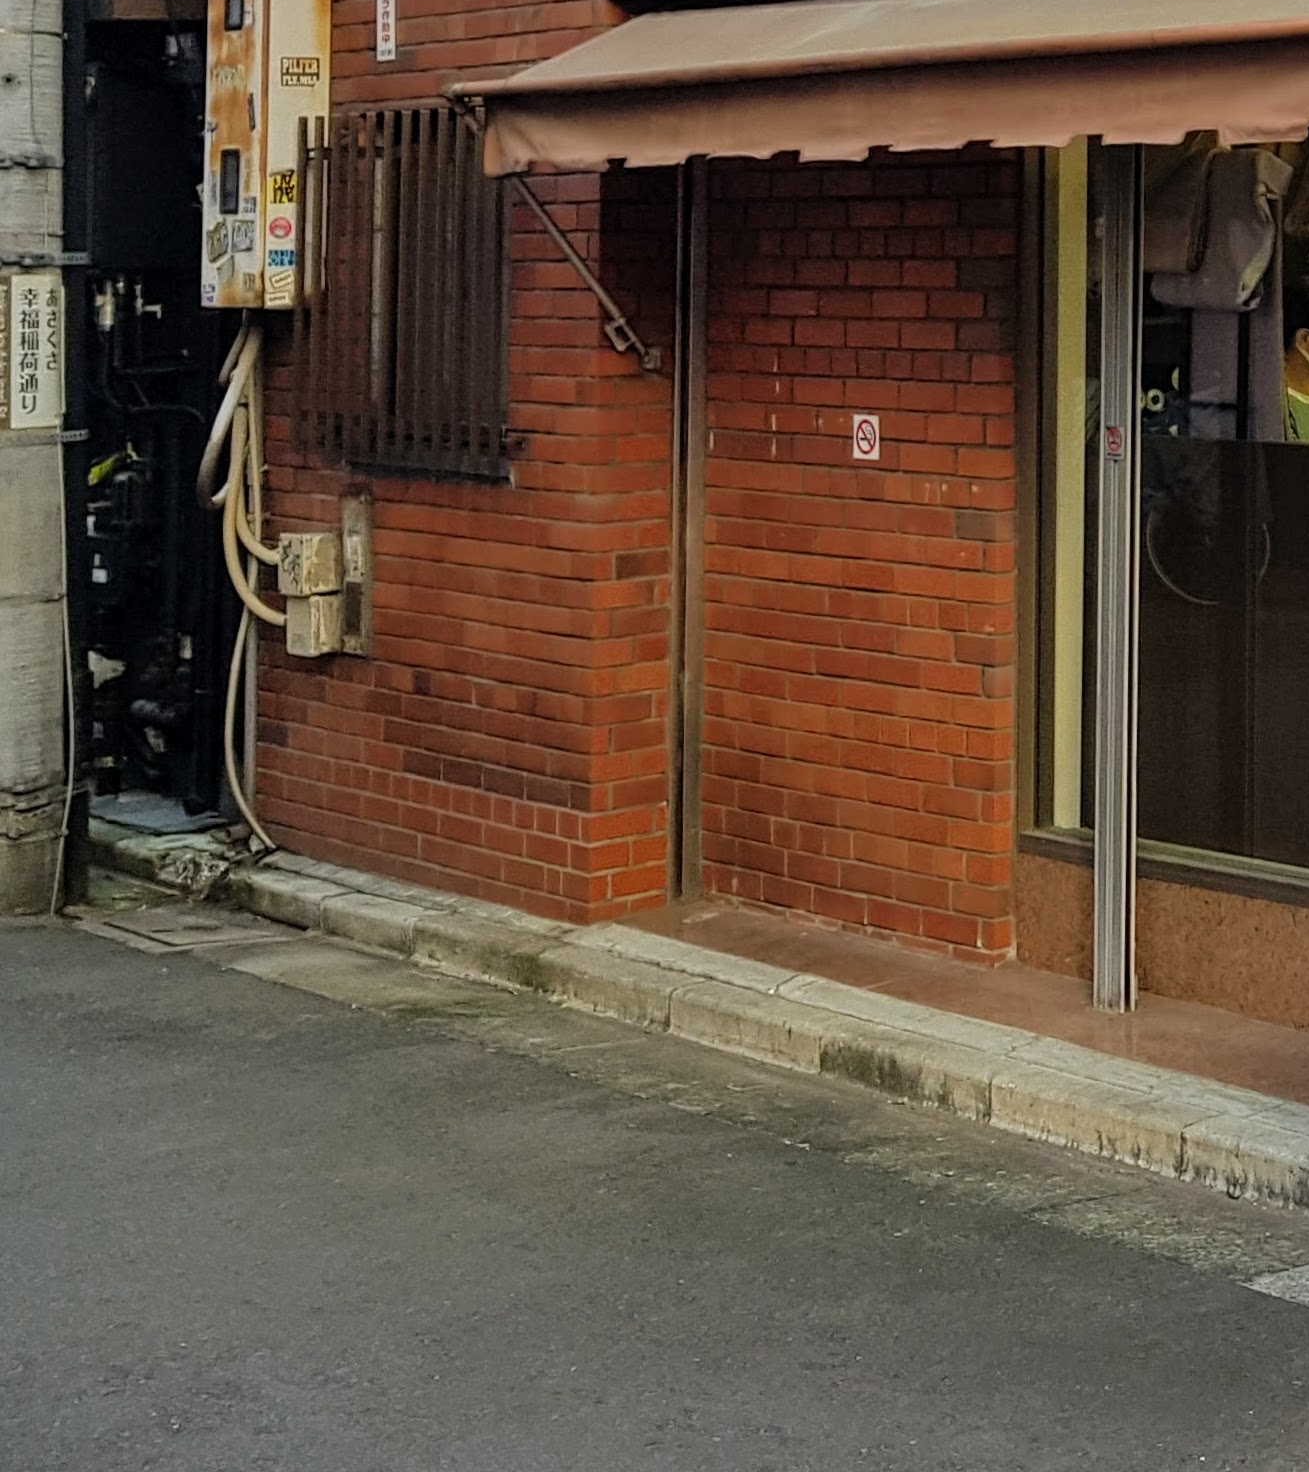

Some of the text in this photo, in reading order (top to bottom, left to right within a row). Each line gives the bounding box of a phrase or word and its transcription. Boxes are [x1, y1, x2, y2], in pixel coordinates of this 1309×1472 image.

[18, 288, 39, 415] 幸福稲荷通り
[45, 288, 58, 371] あさくさ
